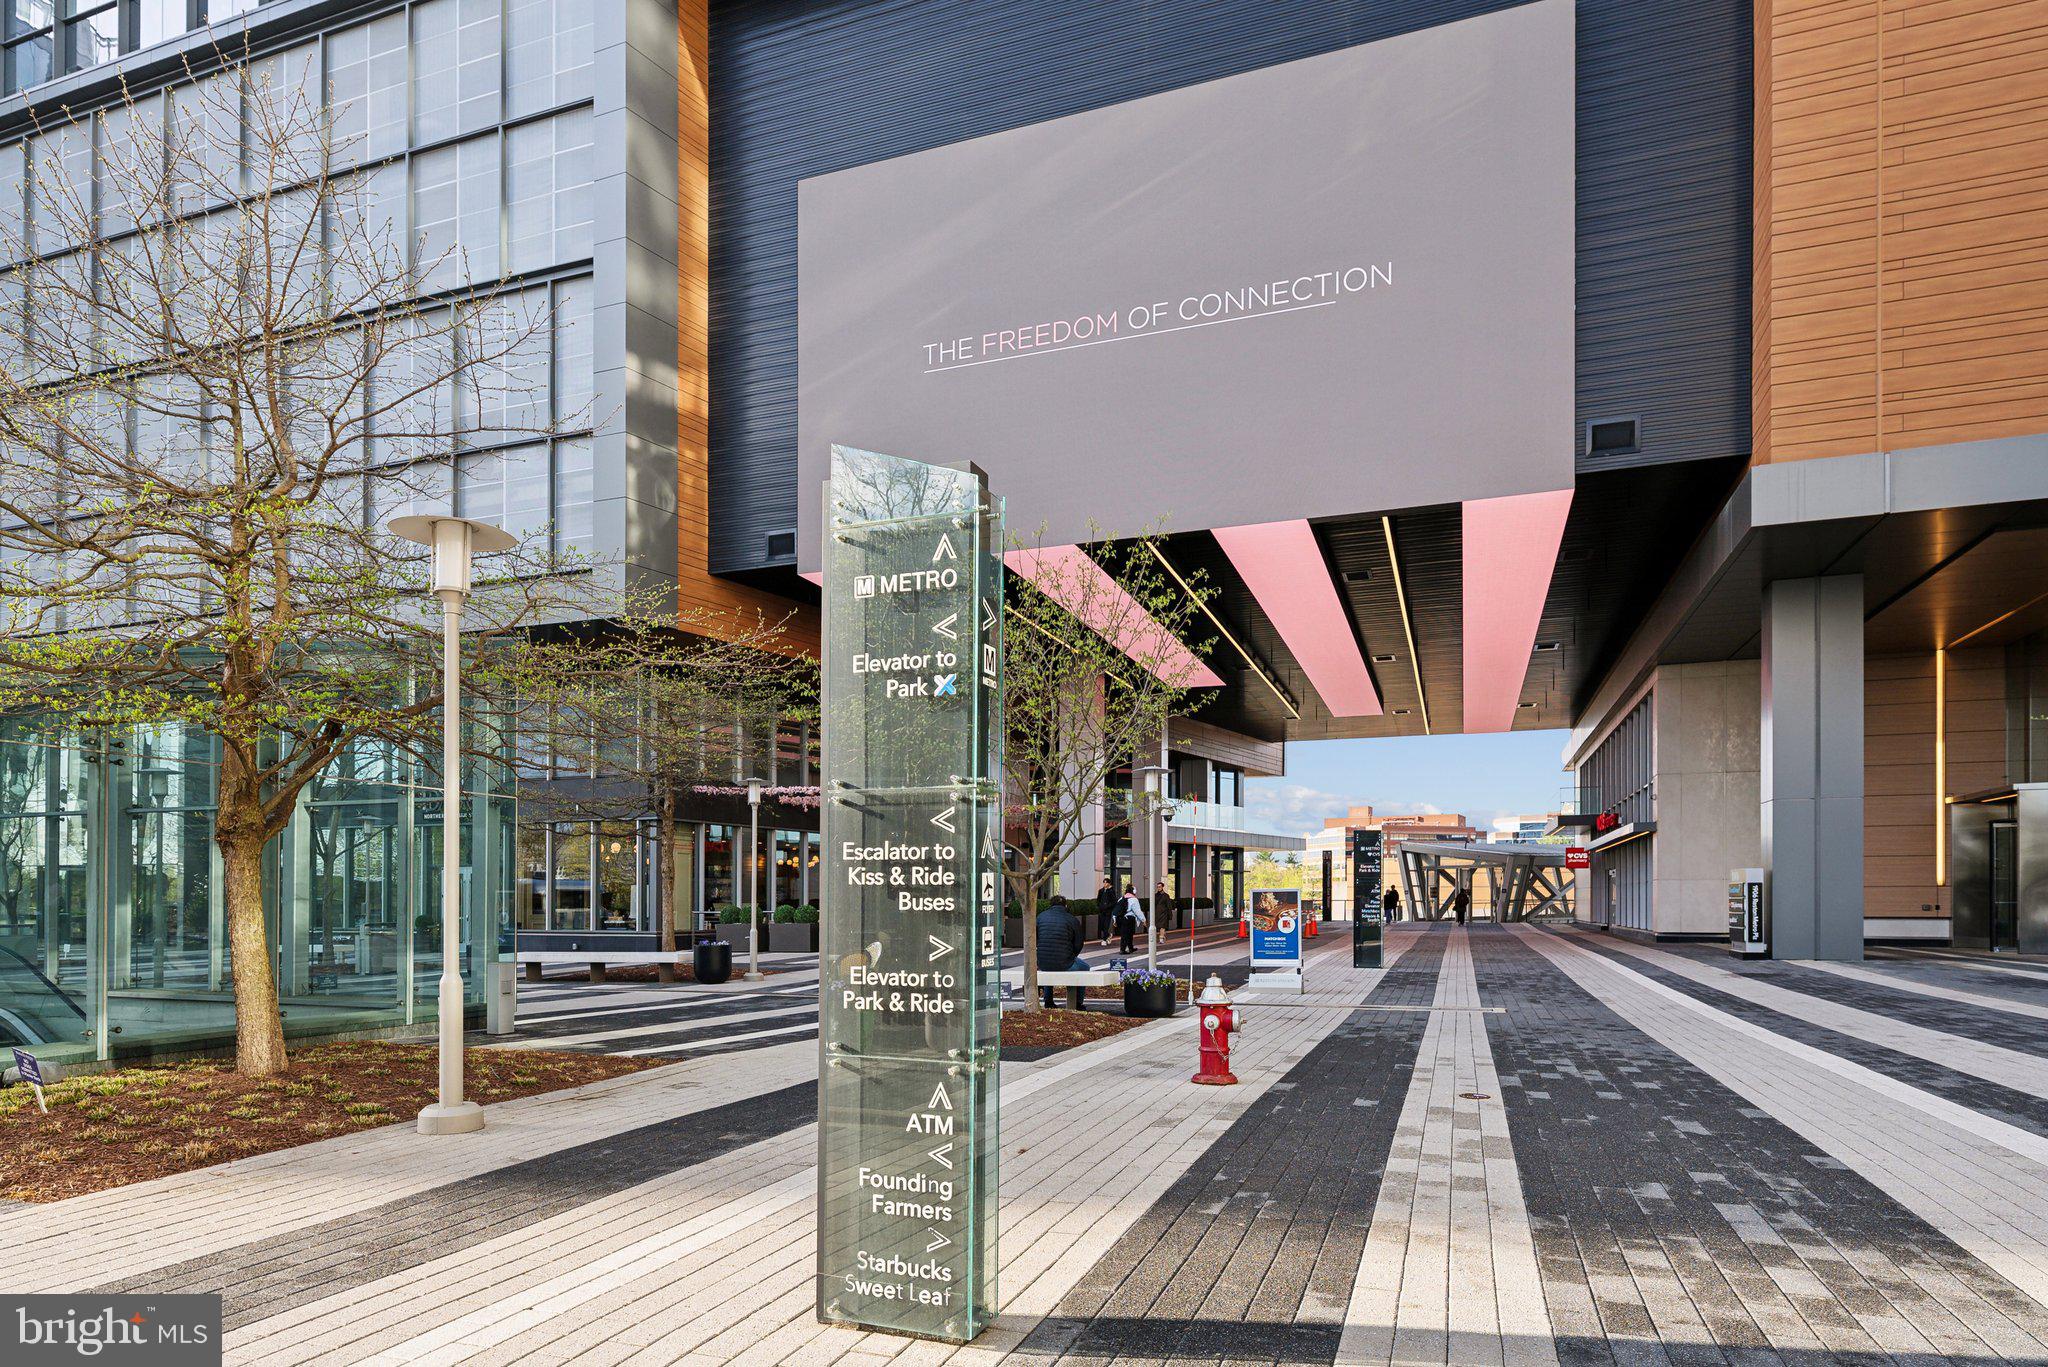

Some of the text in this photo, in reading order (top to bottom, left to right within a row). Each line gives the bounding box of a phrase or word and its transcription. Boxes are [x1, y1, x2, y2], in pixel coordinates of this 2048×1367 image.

[923, 261, 1393, 365] THE FREEDOM OF CONNECTION
[880, 568, 958, 594] METRO
[852, 650, 957, 673] Elevator to
[886, 676, 928, 698] Park
[842, 840, 955, 861] Escalator to
[848, 866, 955, 886] Kiss & Ride
[898, 891, 955, 911] Buses
[981, 957, 995, 968] BUSES
[850, 965, 955, 988] Elevator to
[843, 990, 955, 1014] Park & Ride
[905, 1112, 954, 1136] ATM
[858, 1167, 953, 1201] Founding
[872, 1194, 952, 1222] Farmers
[857, 1250, 952, 1282] Starbucks
[845, 1274, 952, 1307] Sweet Leaf
